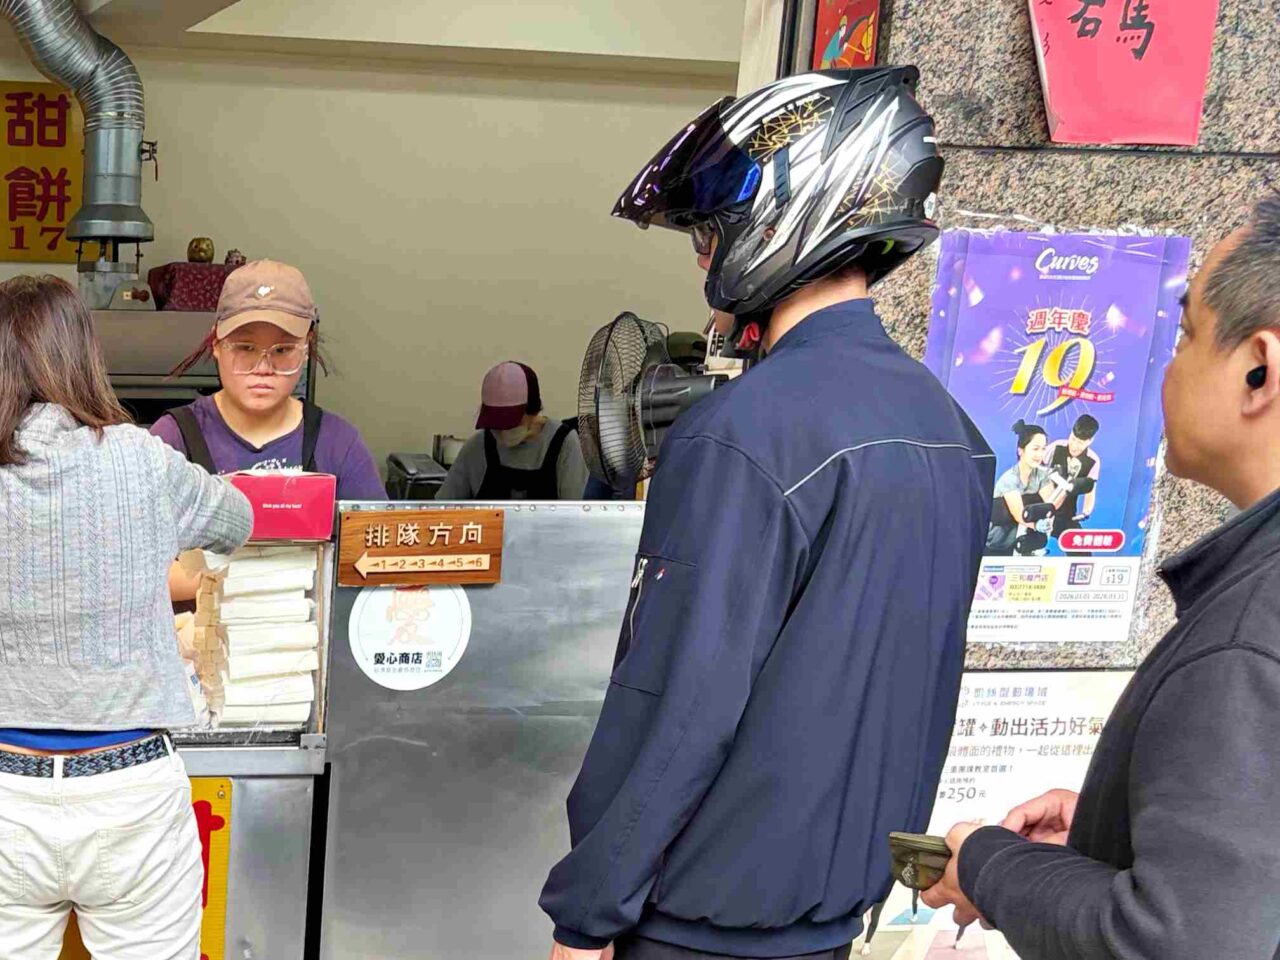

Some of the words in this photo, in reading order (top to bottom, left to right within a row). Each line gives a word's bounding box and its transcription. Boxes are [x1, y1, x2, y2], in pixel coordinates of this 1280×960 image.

[4, 92, 72, 222] 甜餅
[8, 226, 66, 250] 17
[1035, 247, 1099, 275] Curves
[1027, 308, 1092, 334] 週年慶
[1009, 336, 1096, 417] 19
[365, 522, 483, 547] 排隊方向
[373, 651, 423, 665] 愛心商店
[990, 717, 1104, 737] 動出活力好氣
